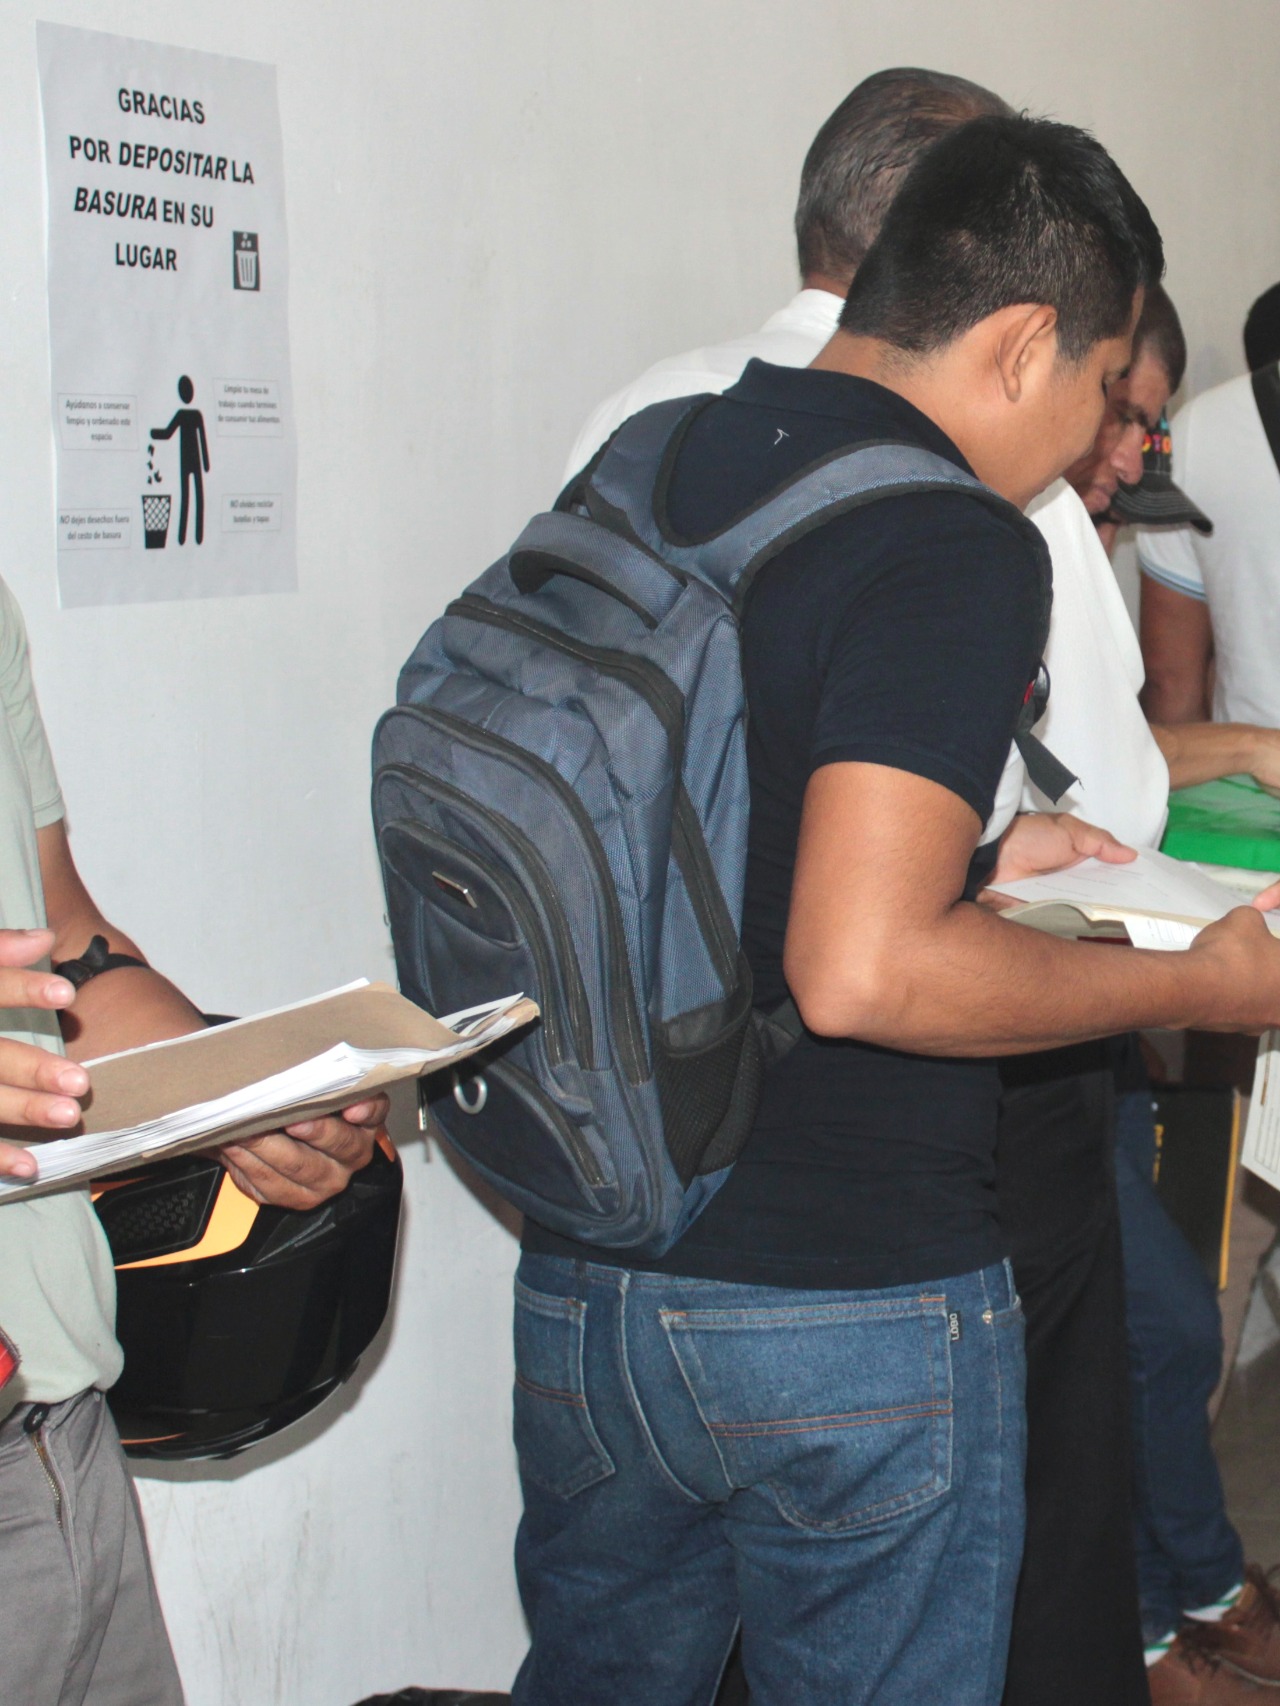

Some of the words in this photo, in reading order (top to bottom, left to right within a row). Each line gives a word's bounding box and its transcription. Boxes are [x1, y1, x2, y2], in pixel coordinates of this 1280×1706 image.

[118, 88, 206, 125] GRACIAS
[69, 135, 112, 164] POR
[118, 141, 229, 181] DEPOSITAR
[231, 160, 255, 184] LA
[74, 186, 158, 221] BASURA
[162, 199, 186, 225] EN
[190, 203, 215, 228] SU
[115, 241, 178, 271] LUGAR
